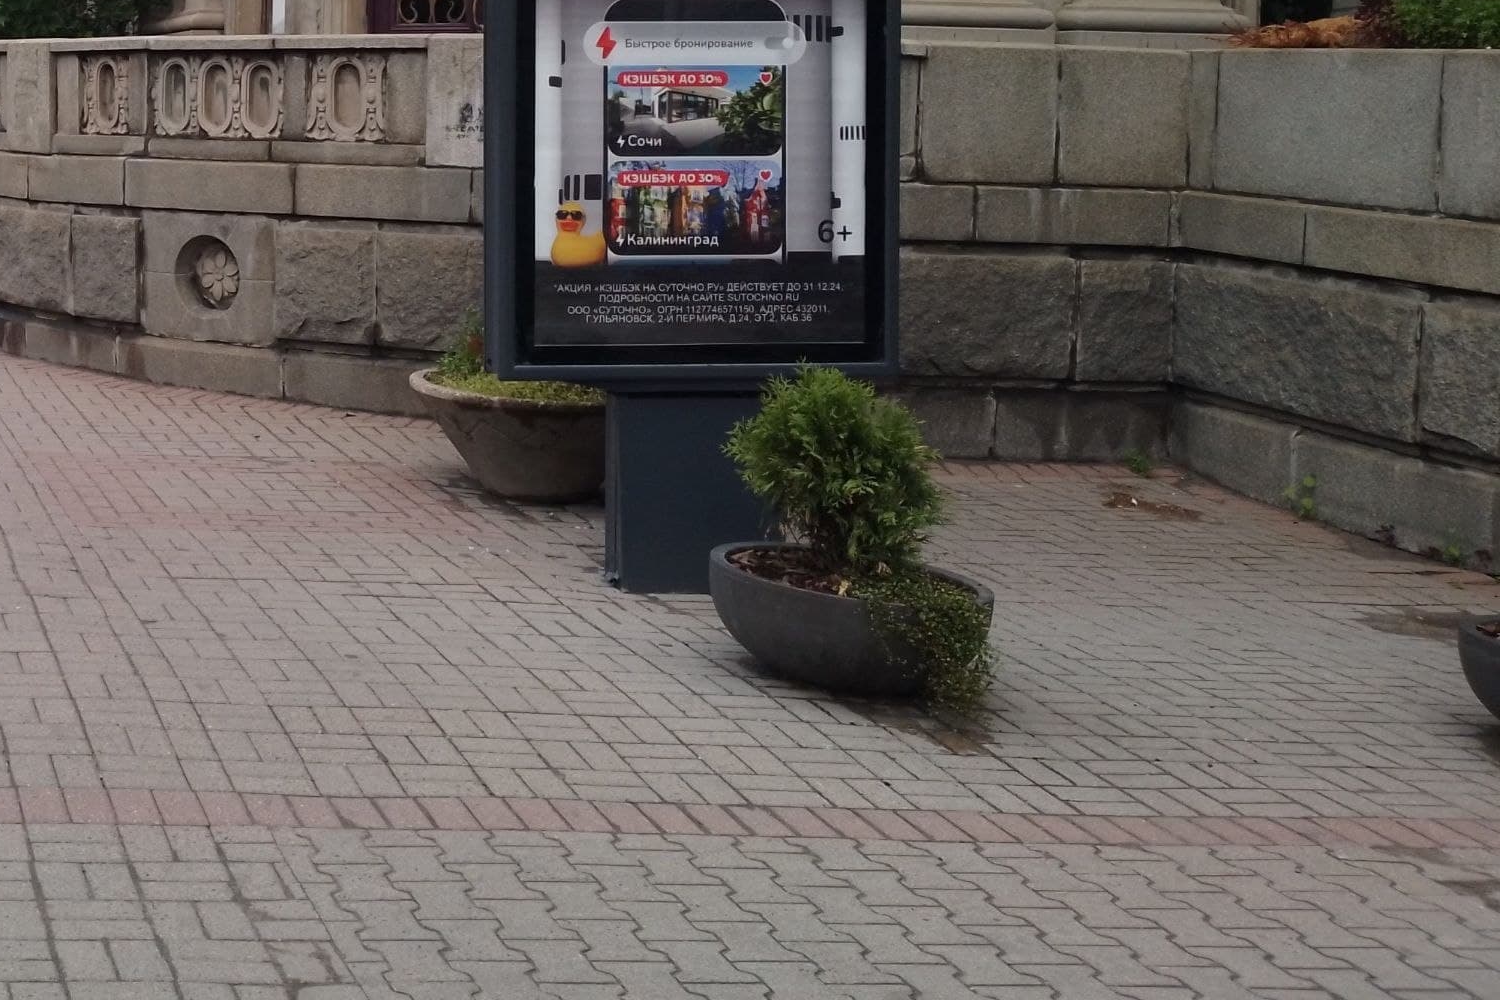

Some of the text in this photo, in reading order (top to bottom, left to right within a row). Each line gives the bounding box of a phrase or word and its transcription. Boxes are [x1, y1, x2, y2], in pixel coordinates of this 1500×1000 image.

[625, 38, 753, 50] Быстрое бронирование
[623, 74, 723, 85] КЭШБЭК ДО 30%
[627, 135, 662, 147] Сочи
[623, 173, 723, 185] КЭШБЭК ДО 30%
[817, 219, 852, 243] 6+
[627, 233, 719, 247] Калининград
[595, 283, 640, 293] «КЭШБЭК
[643, 283, 657, 292] НА
[726, 281, 785, 292] ДЕЙСТВУЕТ
[787, 282, 801, 293] ДО
[599, 293, 674, 303] ПОДРОБНОСТИ
[676, 293, 690, 303] НА
[692, 292, 725, 302] САЙТЕ
[567, 305, 591, 315] ООО
[657, 305, 683, 315] ОГРН
